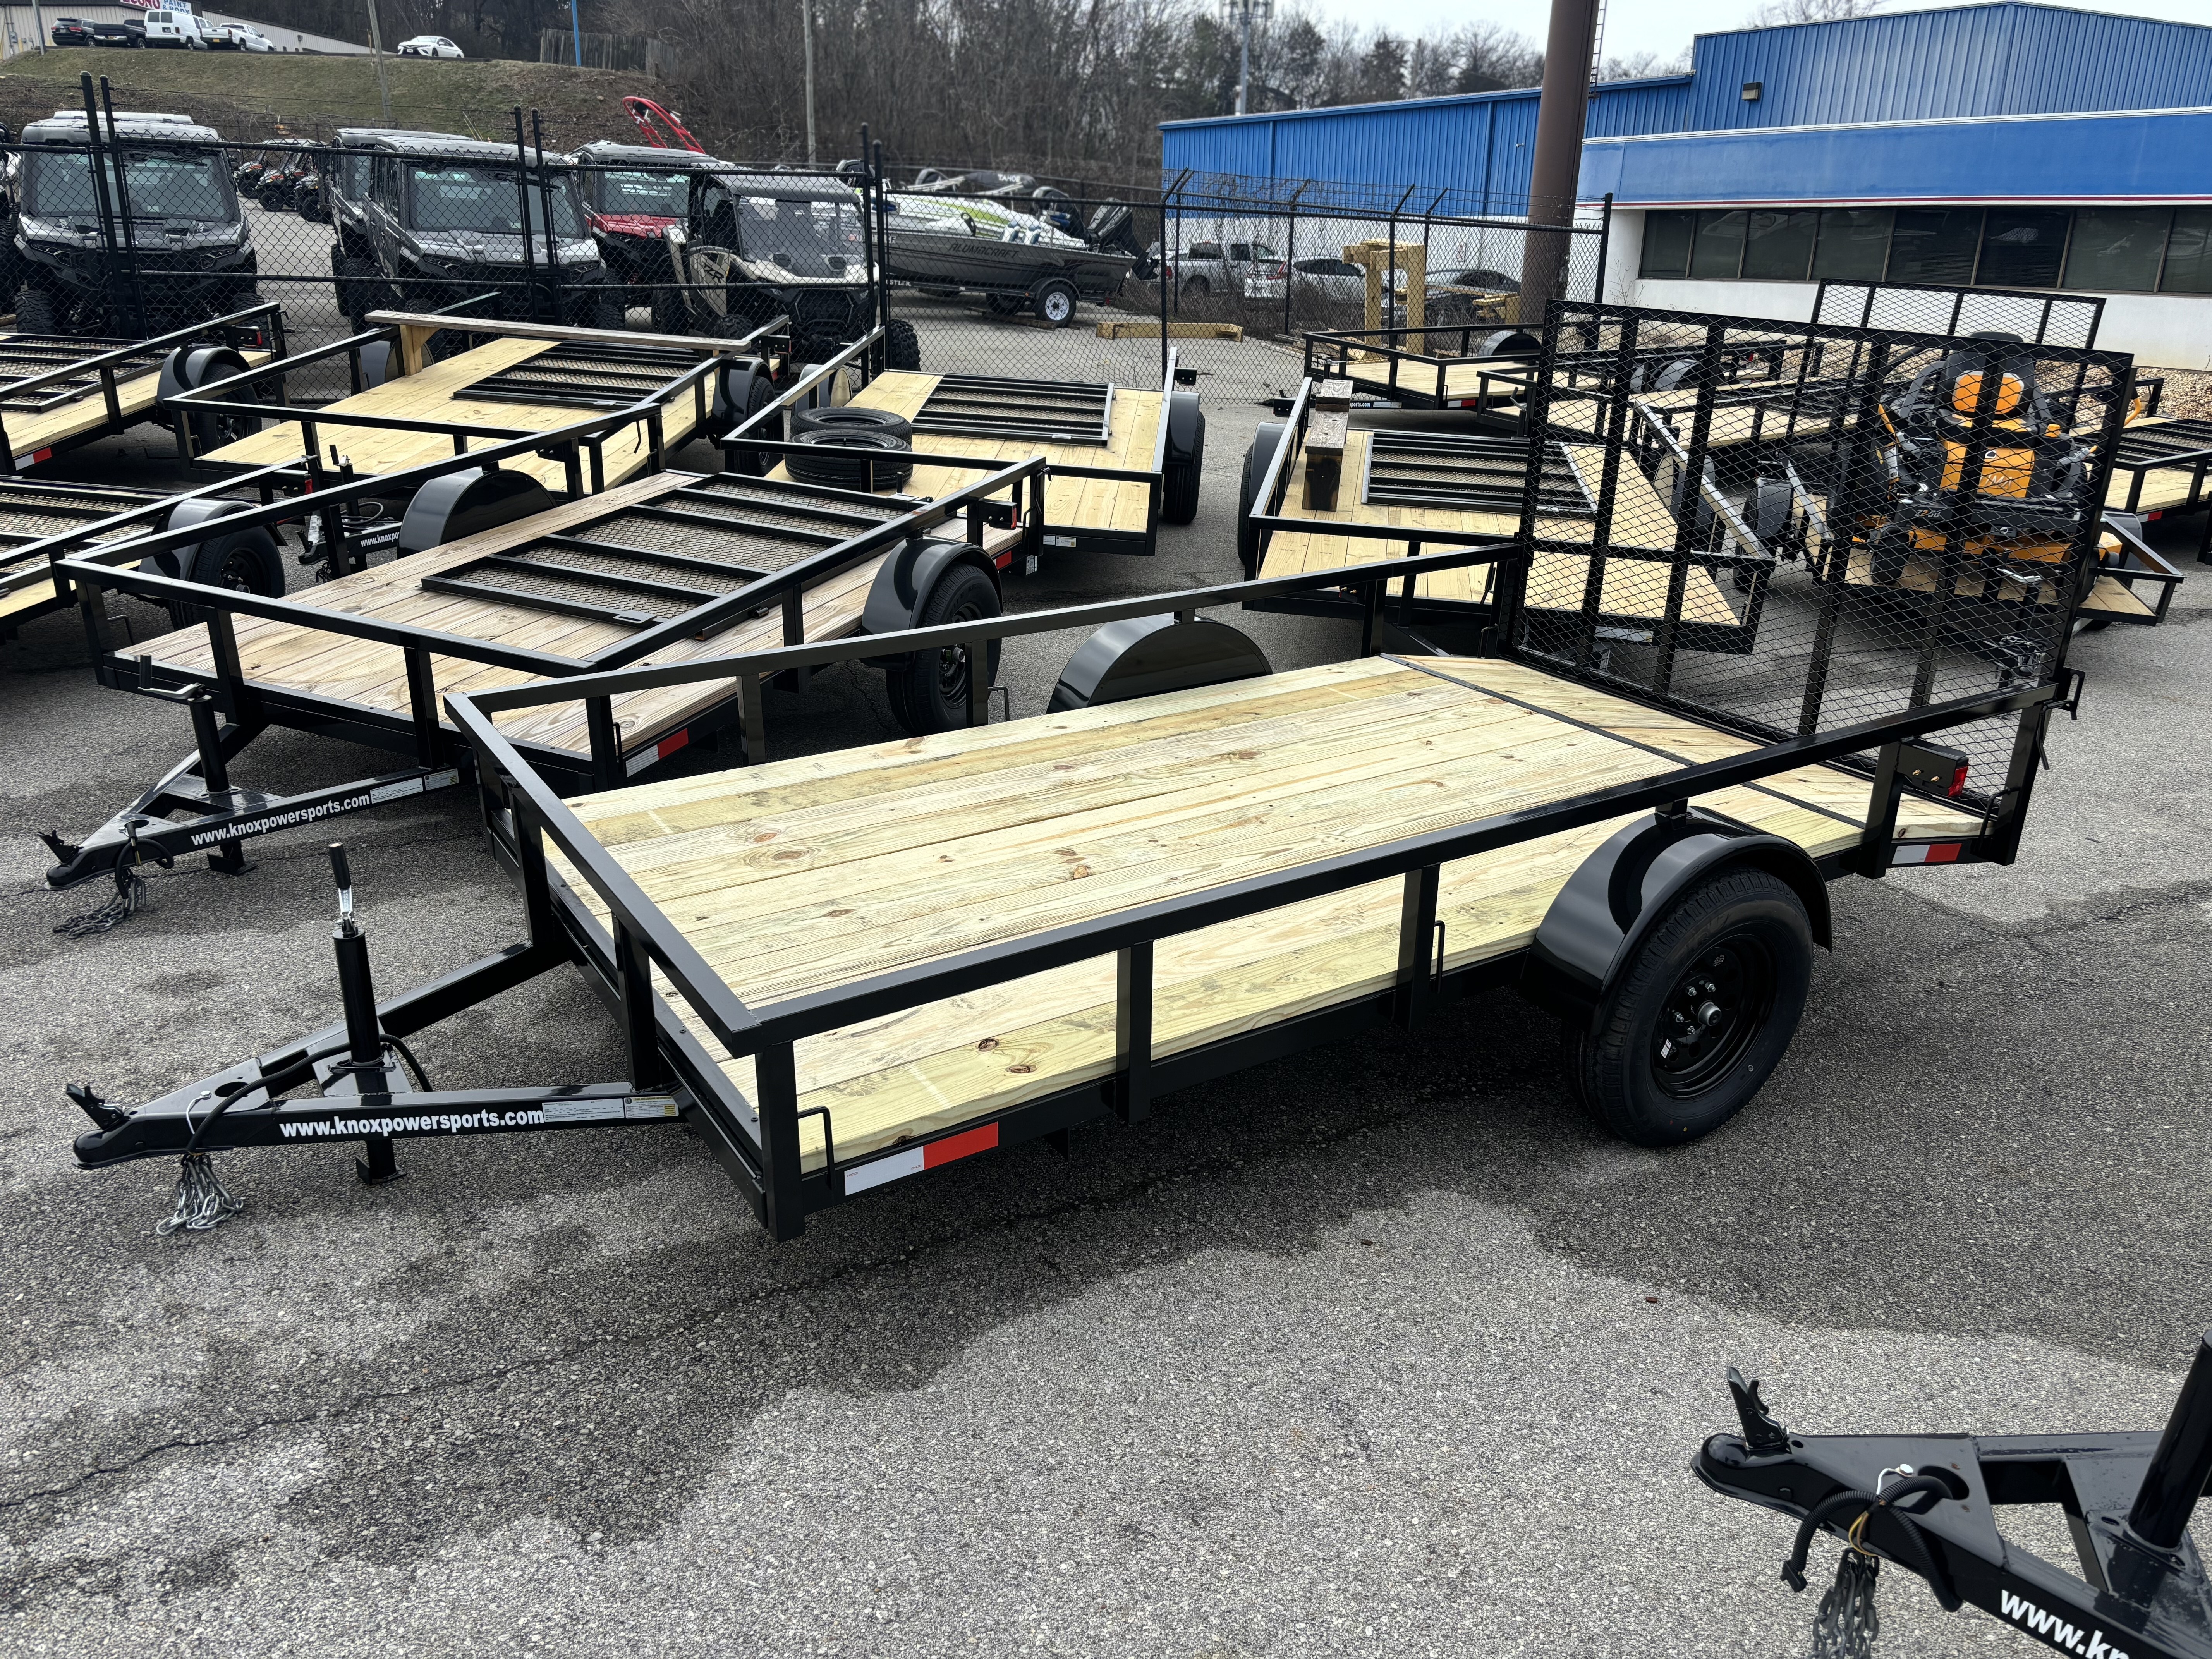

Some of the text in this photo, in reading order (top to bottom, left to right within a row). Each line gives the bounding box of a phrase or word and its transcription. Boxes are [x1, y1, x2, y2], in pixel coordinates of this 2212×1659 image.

[123, 0, 160, 9] ONO
[998, 174, 1020, 182] TAHOE
[948, 243, 1020, 258] ALUMACRAFT
[360, 532, 400, 547] www.knoxpo
[191, 794, 370, 846] www.knoxpowersports.com
[279, 1109, 545, 1137] www.knoxpowersports.com
